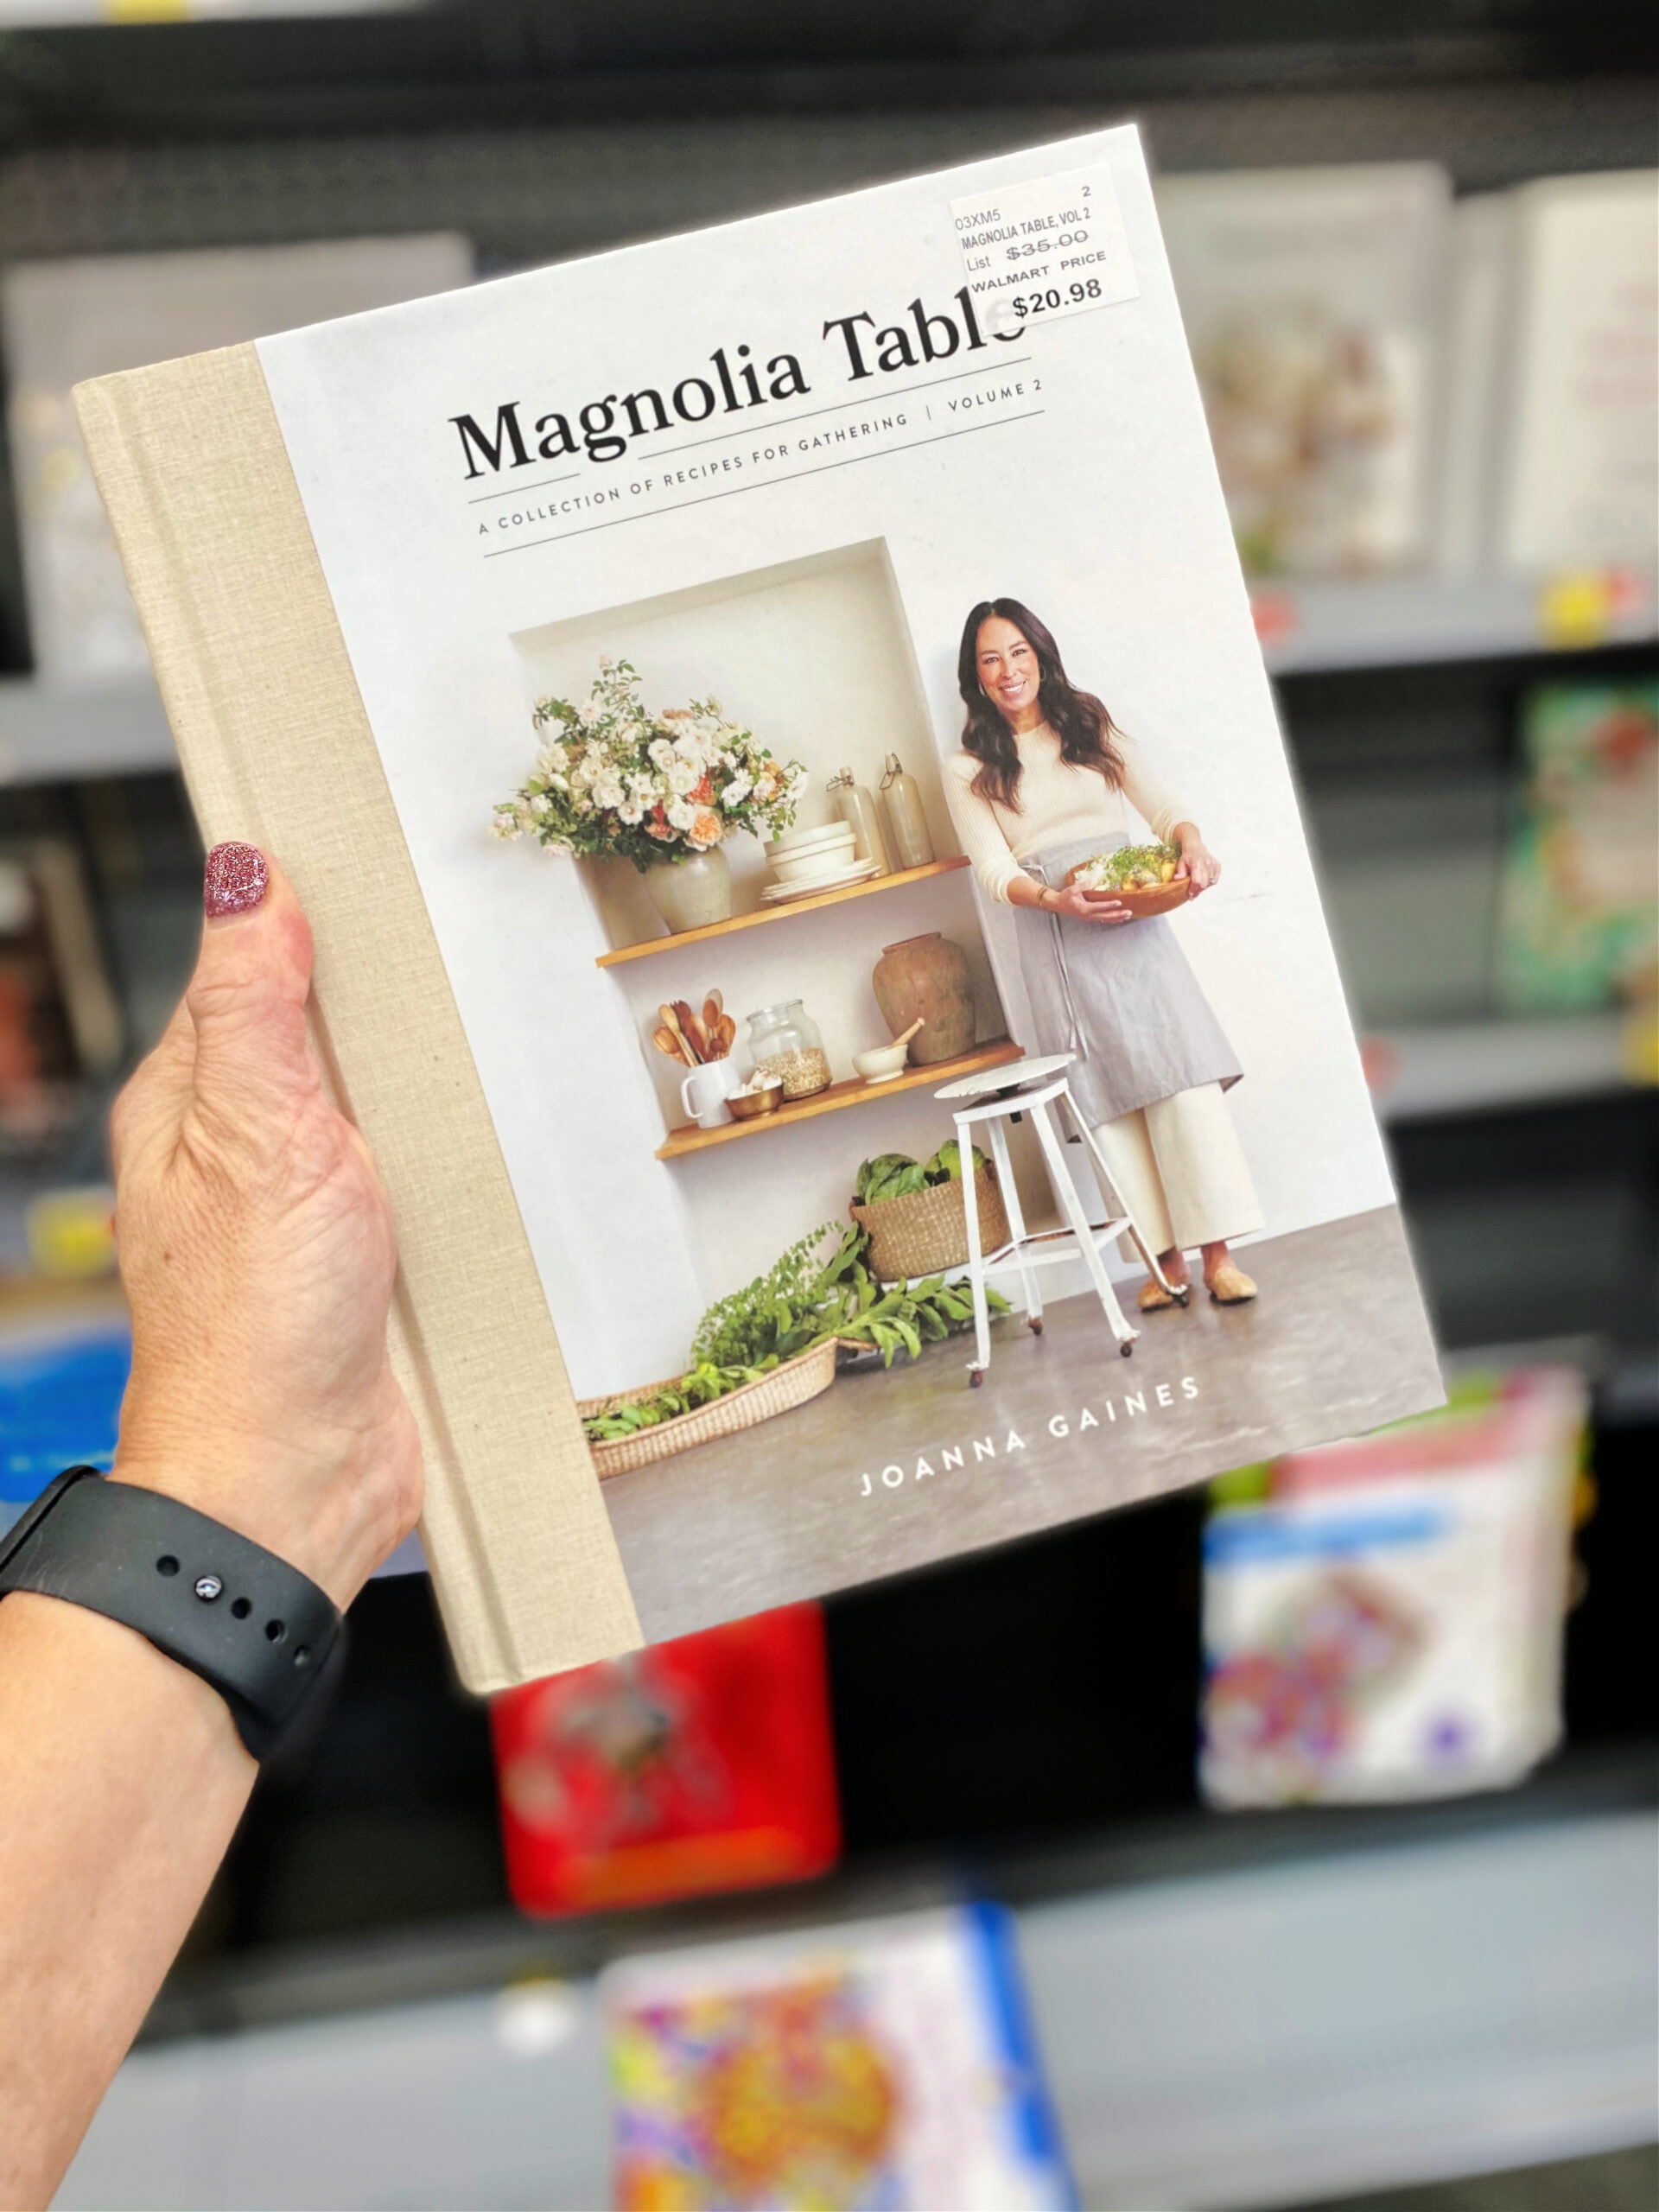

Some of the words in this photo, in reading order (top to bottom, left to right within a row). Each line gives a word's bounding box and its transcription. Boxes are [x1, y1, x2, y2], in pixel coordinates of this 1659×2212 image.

[1081, 186, 1091, 197] 2
[955, 209, 1001, 231] 03XM5
[962, 226, 1020, 250] MAGNOLIA
[1020, 215, 1059, 235] TABLE,
[1058, 208, 1080, 225] VOL
[1084, 207, 1090, 219] 2
[966, 255, 991, 271] List
[1006, 230, 1089, 261] $35.00
[971, 266, 1050, 293] WALMART
[1060, 251, 1107, 270] PRICE
[1013, 278, 1103, 319] $20.98
[447, 344, 810, 480] Magnolia
[478, 523, 489, 535] A
[498, 488, 620, 529] COLLECTION
[630, 480, 654, 495] OF
[664, 456, 743, 487] RECIPES
[752, 444, 789, 464] FOR
[798, 414, 908, 452] GATHERING
[948, 383, 1026, 412] VOLUME
[1033, 379, 1043, 391] 2
[860, 1429, 1027, 1497] JOANNA
[1047, 1376, 1199, 1438] GAINES
